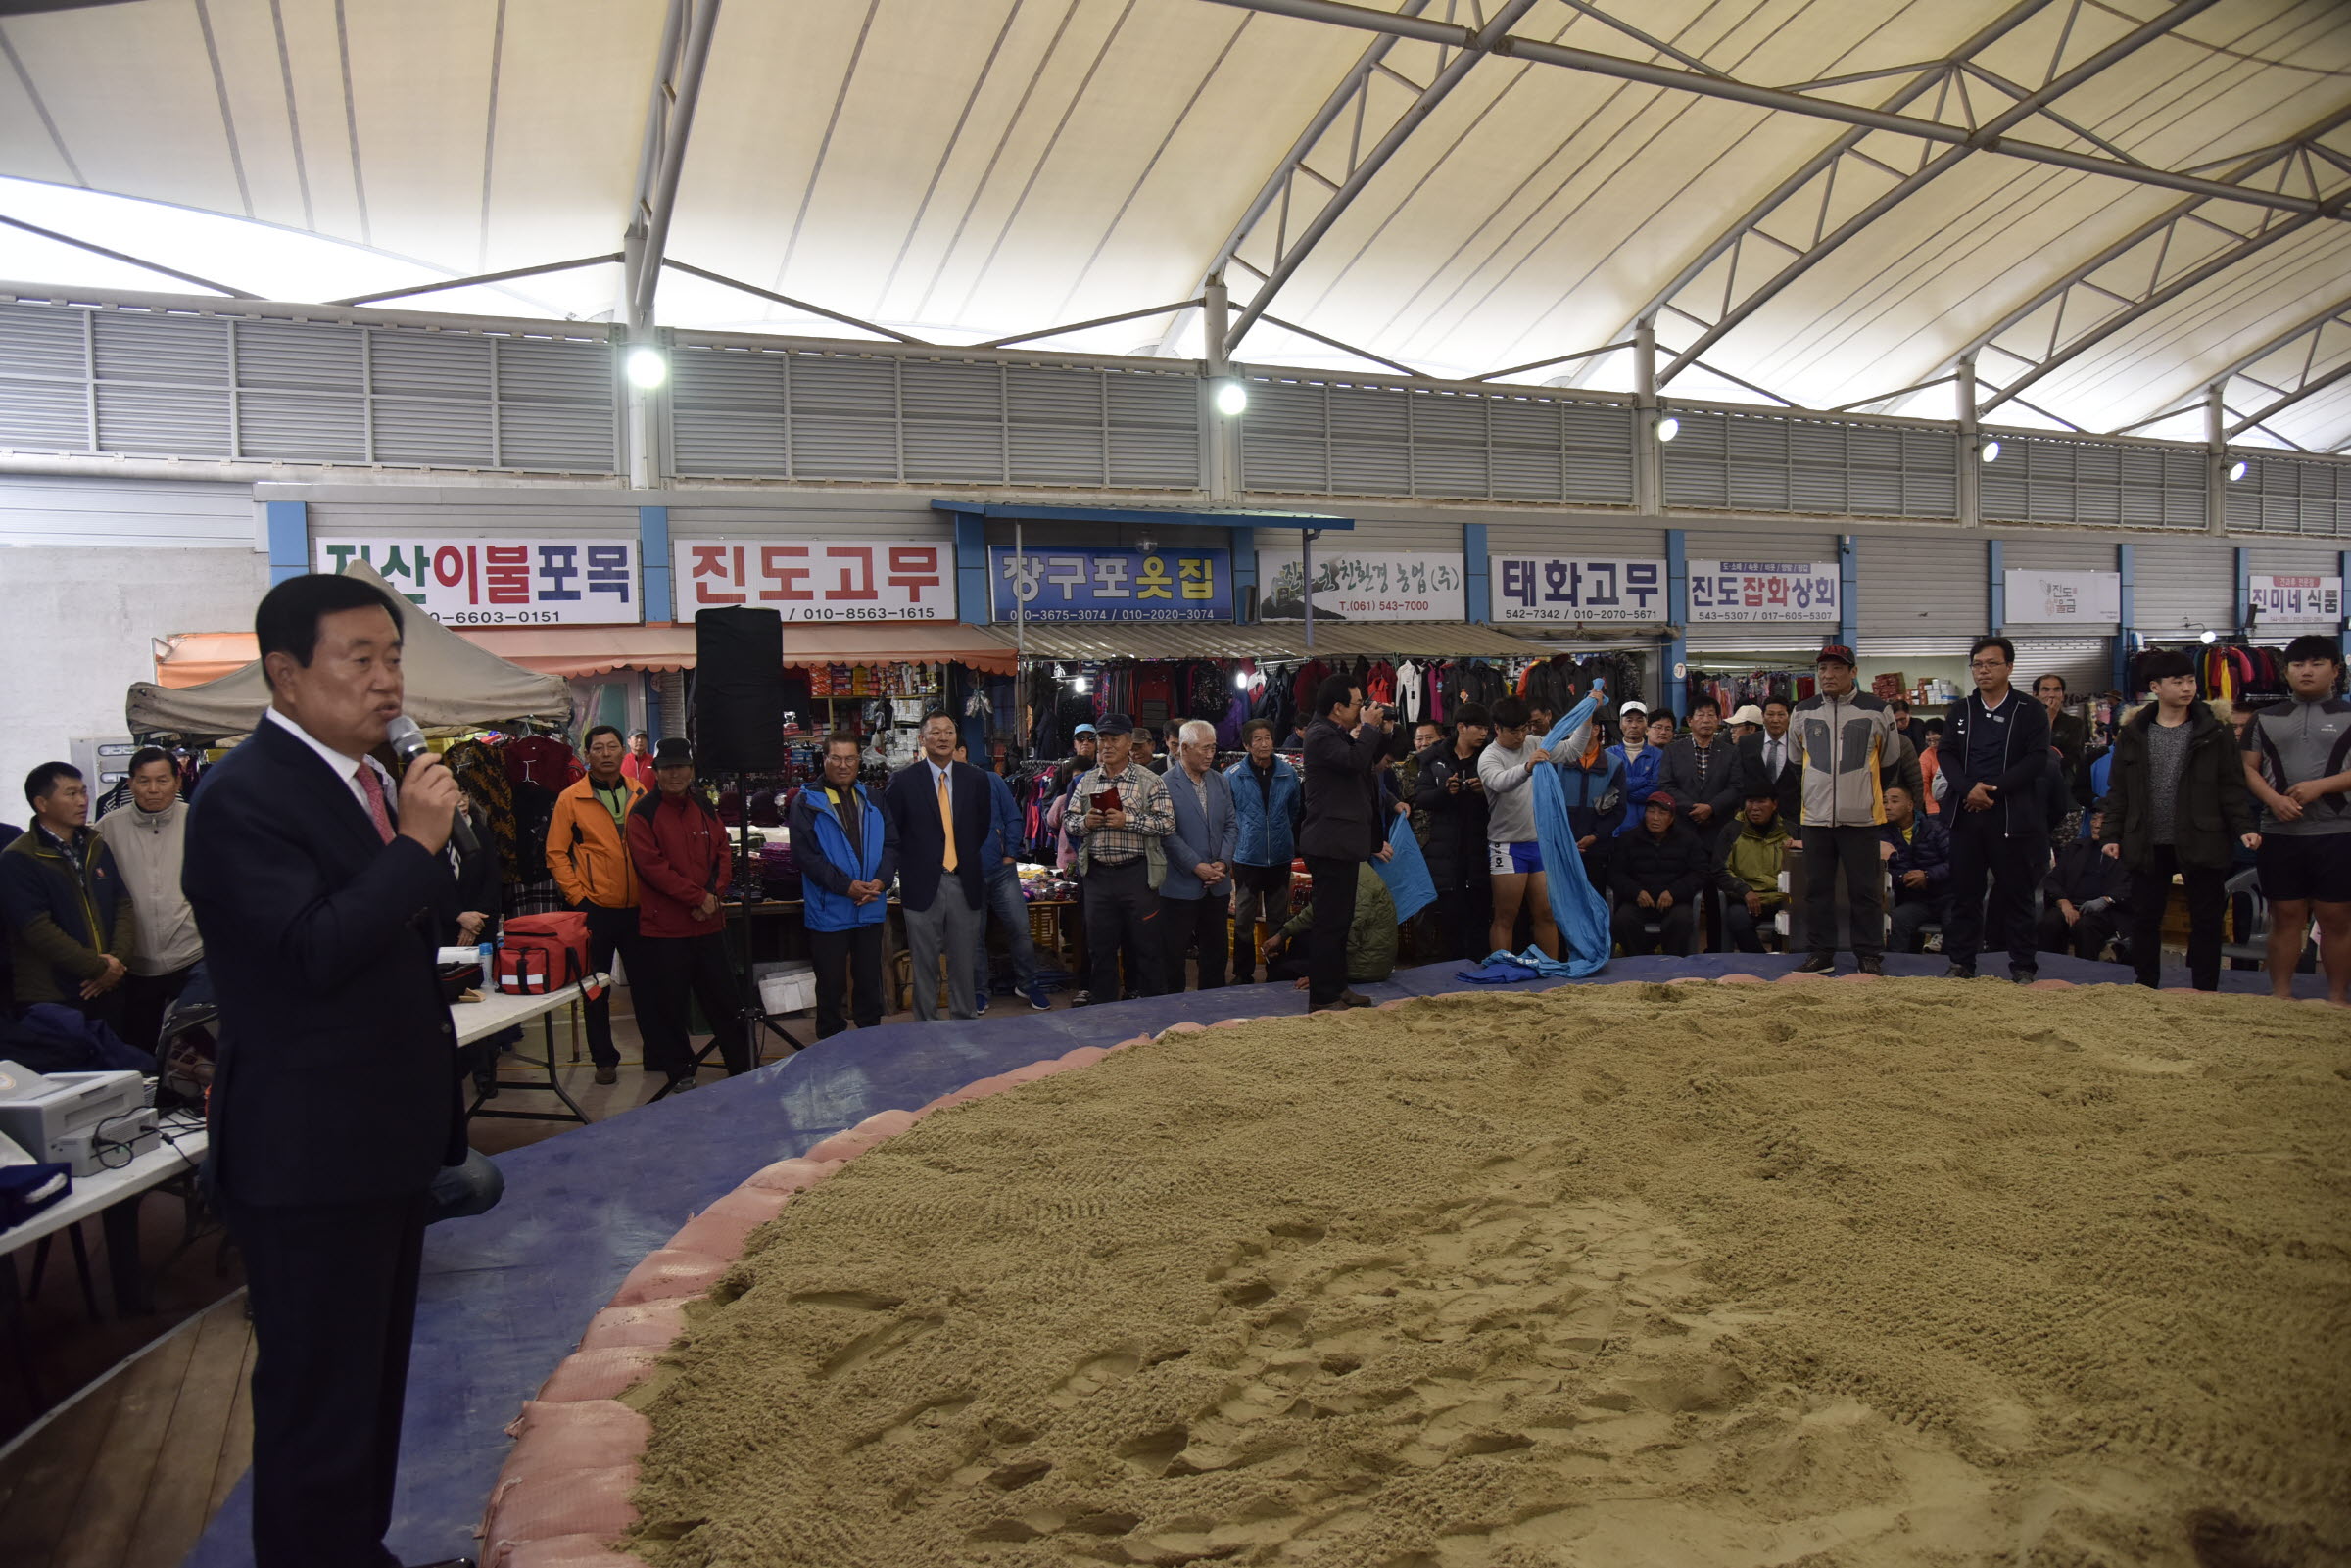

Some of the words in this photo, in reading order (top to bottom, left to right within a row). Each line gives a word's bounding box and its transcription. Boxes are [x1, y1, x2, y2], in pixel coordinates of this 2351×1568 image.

[692, 546, 940, 604] 진도고무
[1002, 556, 1214, 602] 장구포옷집
[1281, 561, 1336, 593] 진군
[1502, 559, 1658, 608] 태화고무
[1379, 600, 1429, 611] 543-7000
[803, 607, 935, 620] 010-8563-1615
[1010, 609, 1107, 621] 00-3675-3074
[1122, 609, 1214, 620] 010-2020-3074
[1506, 609, 1559, 619] 542-7342
[1574, 609, 1656, 619] 010-2070-5671
[1699, 611, 1749, 620] 543-5307
[1761, 611, 1832, 620] 017-605-5307
